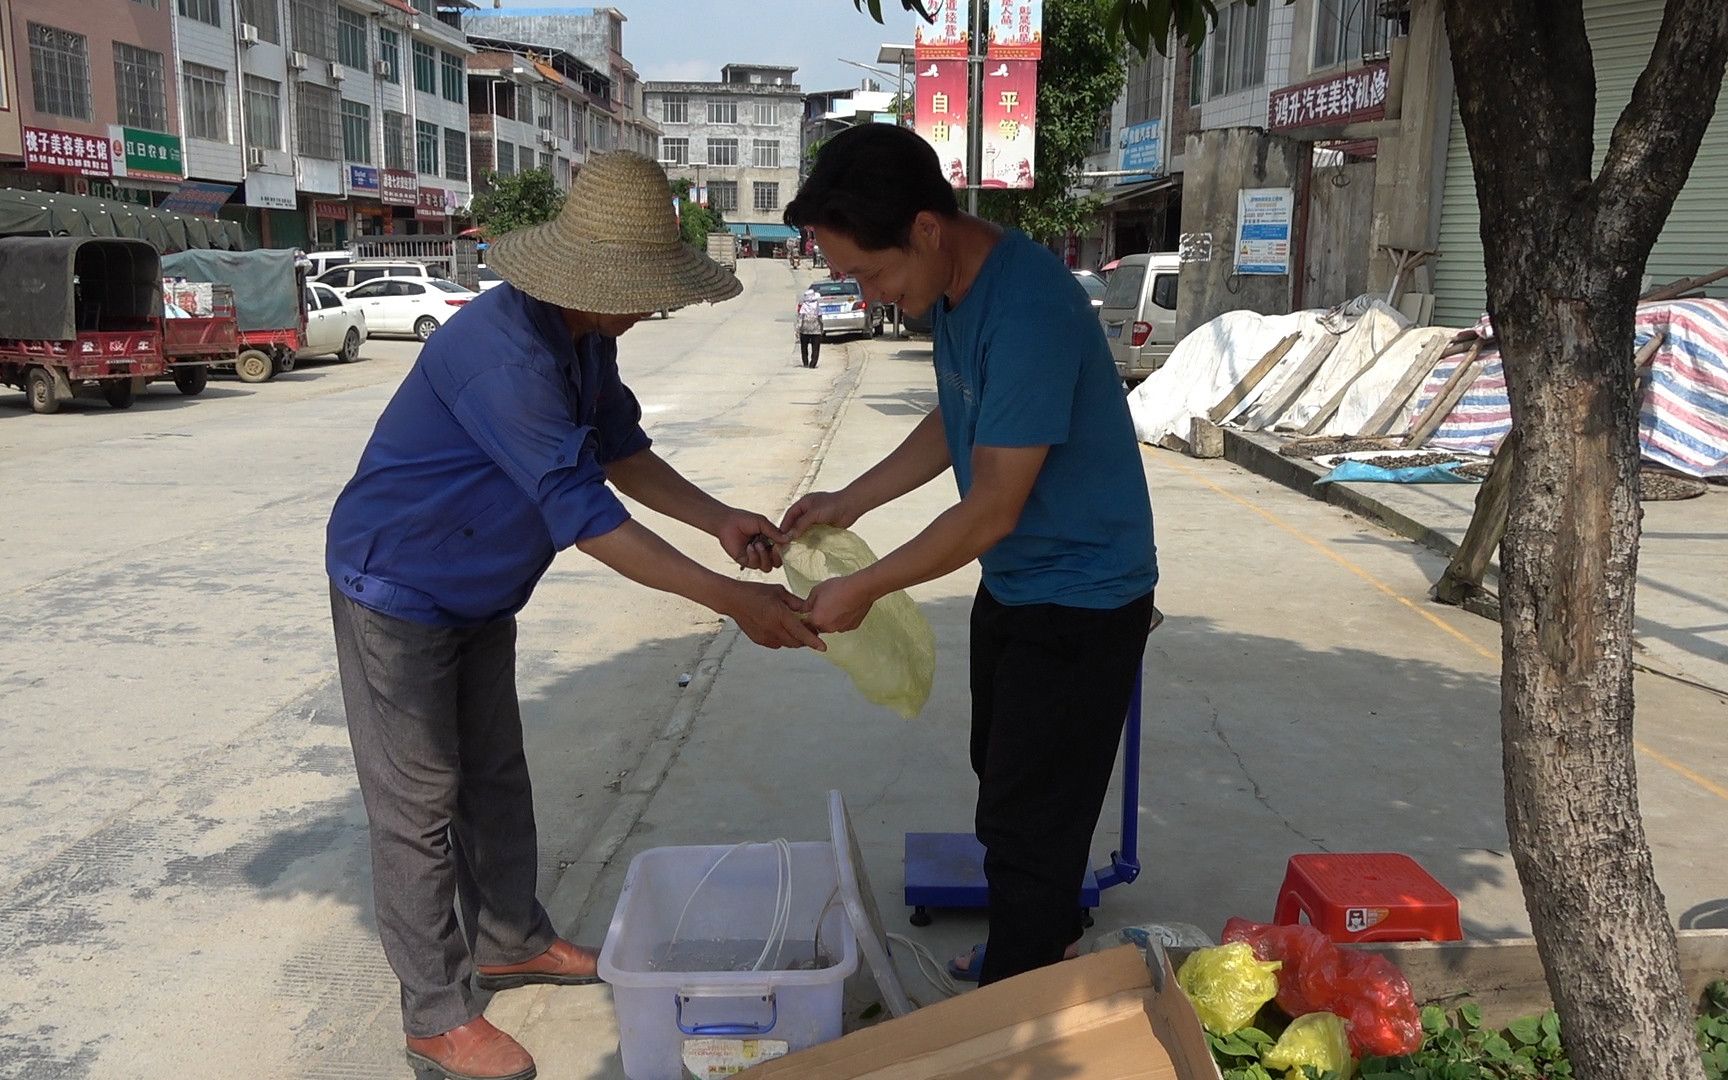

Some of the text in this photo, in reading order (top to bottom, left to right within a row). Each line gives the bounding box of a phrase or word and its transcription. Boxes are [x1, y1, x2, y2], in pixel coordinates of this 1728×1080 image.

[932, 92, 950, 142] 自由
[999, 91, 1020, 141] 平等
[1275, 69, 1389, 126] 鸿升汽车美容机修
[26, 130, 107, 160] 桃子美容养生馆
[127, 141, 167, 160] 红日农业
